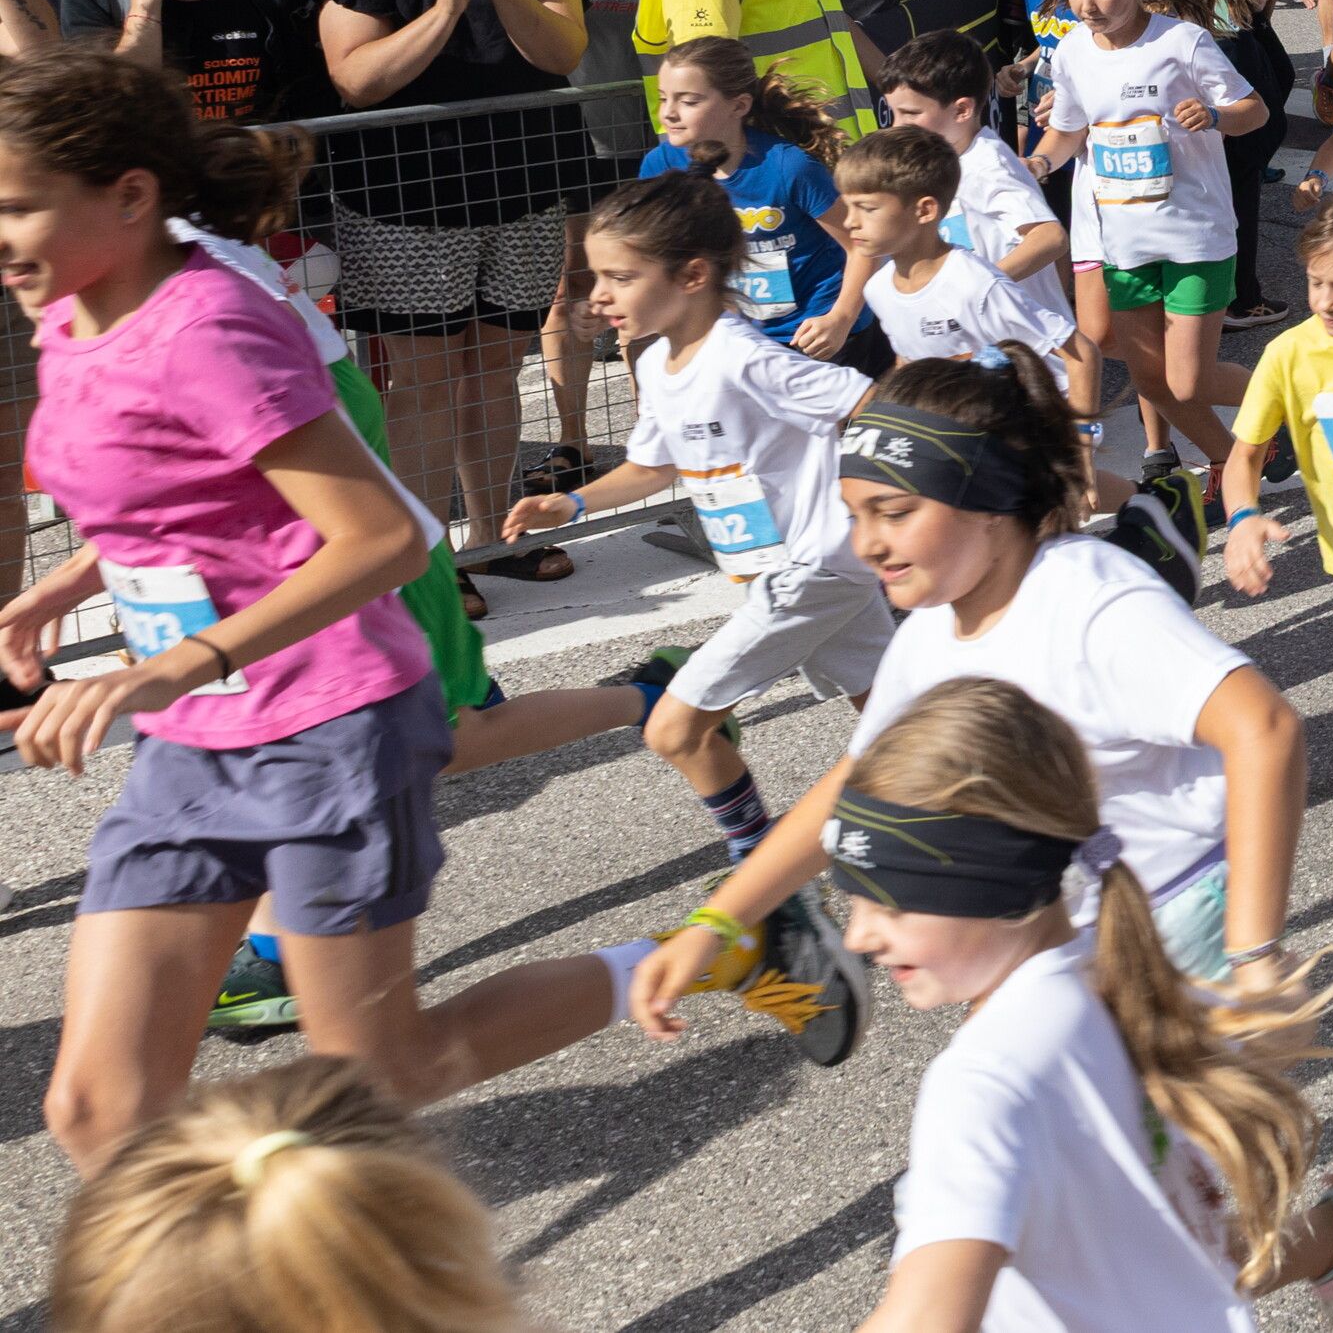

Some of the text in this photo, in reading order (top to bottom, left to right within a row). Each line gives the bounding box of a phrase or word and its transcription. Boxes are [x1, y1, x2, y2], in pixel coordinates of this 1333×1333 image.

[593, 1, 638, 11] XTREM
[204, 57, 260, 69] saucony
[192, 84, 257, 104] XTREME
[192, 106, 229, 122] RAIL
[1103, 150, 1153, 174] 6155
[704, 513, 753, 546] 02
